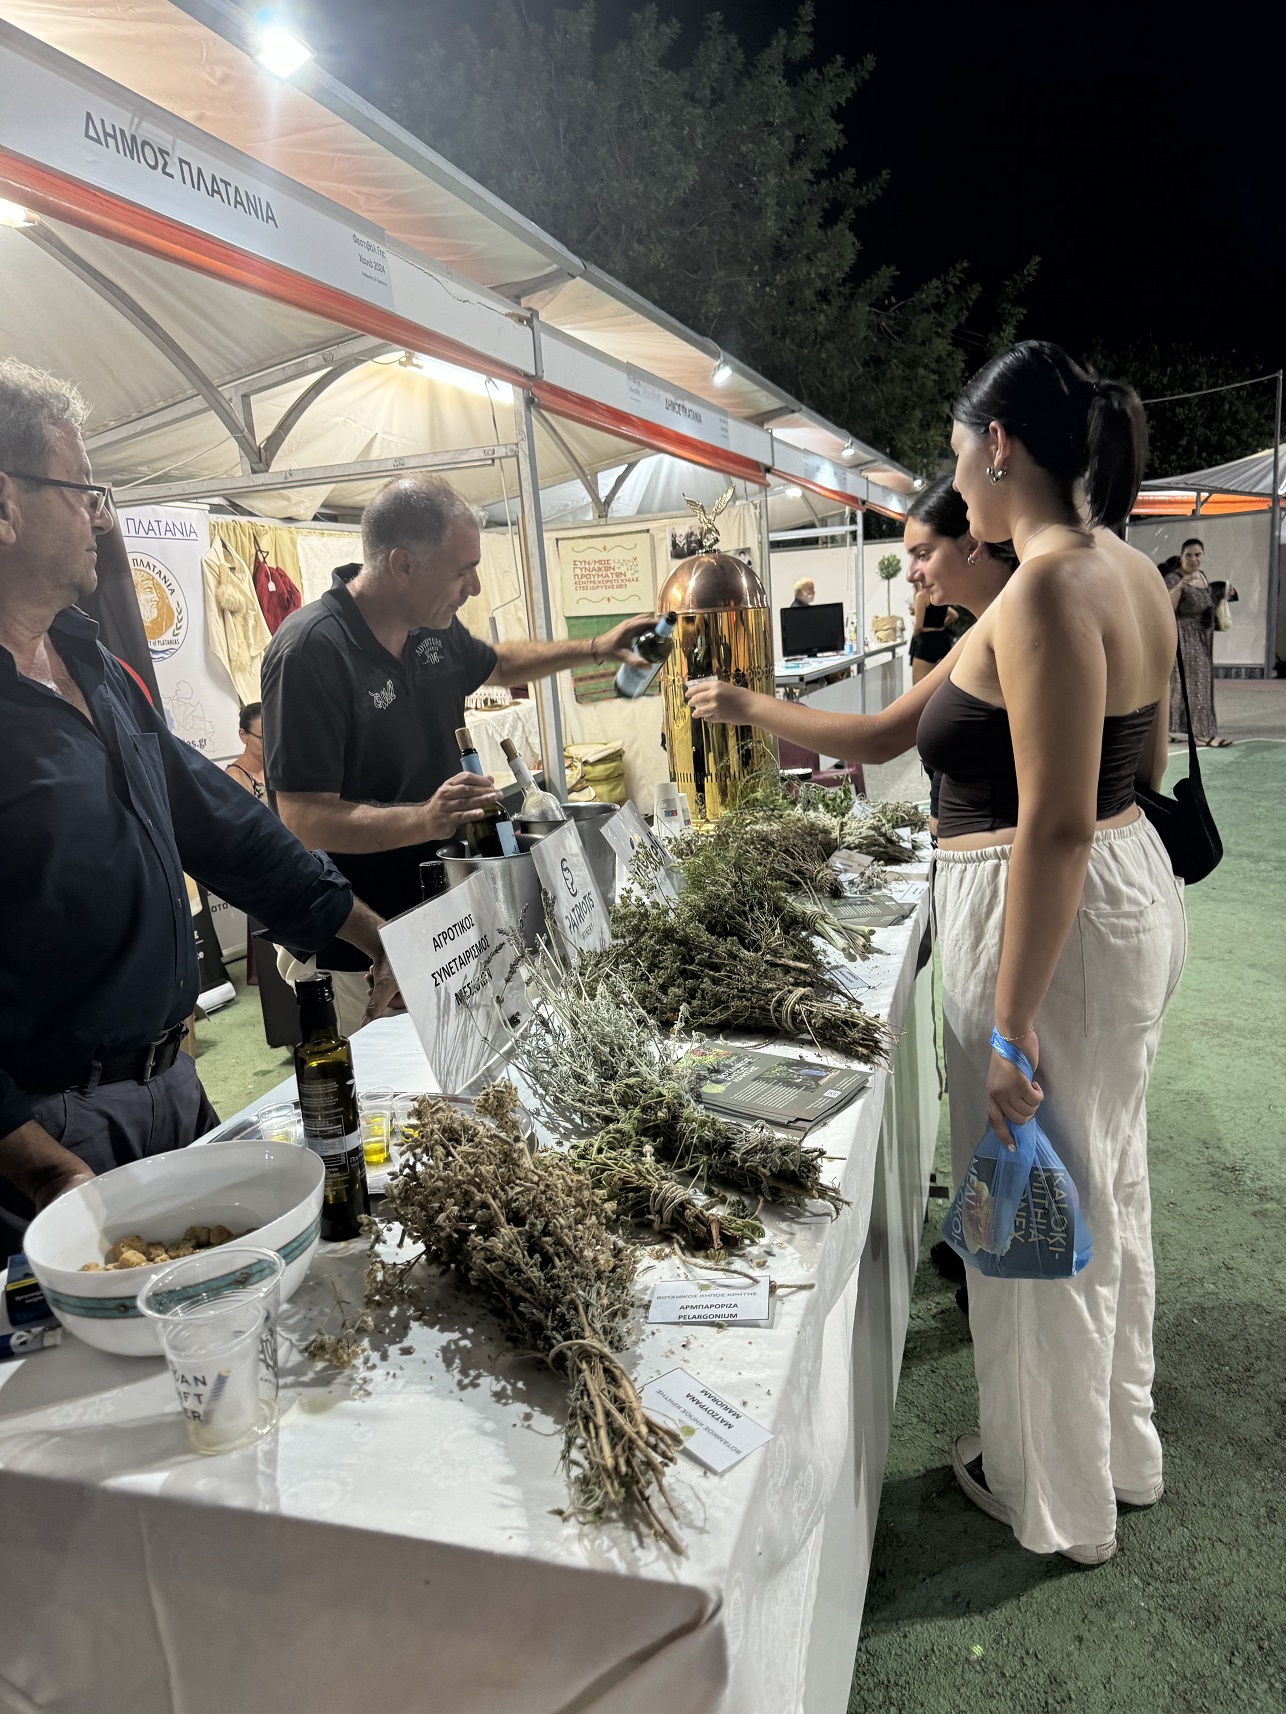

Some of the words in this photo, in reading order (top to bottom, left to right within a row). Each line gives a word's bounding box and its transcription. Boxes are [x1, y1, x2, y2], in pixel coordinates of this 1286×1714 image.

[84, 110, 175, 180] ΔΗΜΟΣ
[178, 156, 279, 229] ΠΛΑΤΑΝΙΑ
[126, 517, 199, 538] ΠΛΑΤΑΝΙΑ
[573, 559, 612, 567] ΣΥΝ/ΜΟΣ
[573, 565, 616, 574] ΓΥΝΑΙΚΩΝ
[132, 558, 176, 596] ΠΛΑΤΑΝΙΑ
[432, 913, 475, 952] ΑΓΡΟΤΙΚΟΣ
[431, 935, 490, 988] ΣΥΝΕΤΑΙΡΙΣΜΟΣ
[678, 1313, 738, 1321] PELARGONIUM
[679, 1303, 738, 1311] ΑΡΜΠΑΡΟΡΙΖΑ
[656, 1389, 682, 1410] ΚΡΗΤΗΣ
[685, 1392, 734, 1430] ΜΑΤΖΟΥΡΑΝΑ
[700, 1388, 742, 1420] MARJORAM
[682, 1408, 704, 1428] ΚΗΠΟΣ
[704, 1425, 742, 1455] ΒΟΤΑΝΙΚΟΣ
